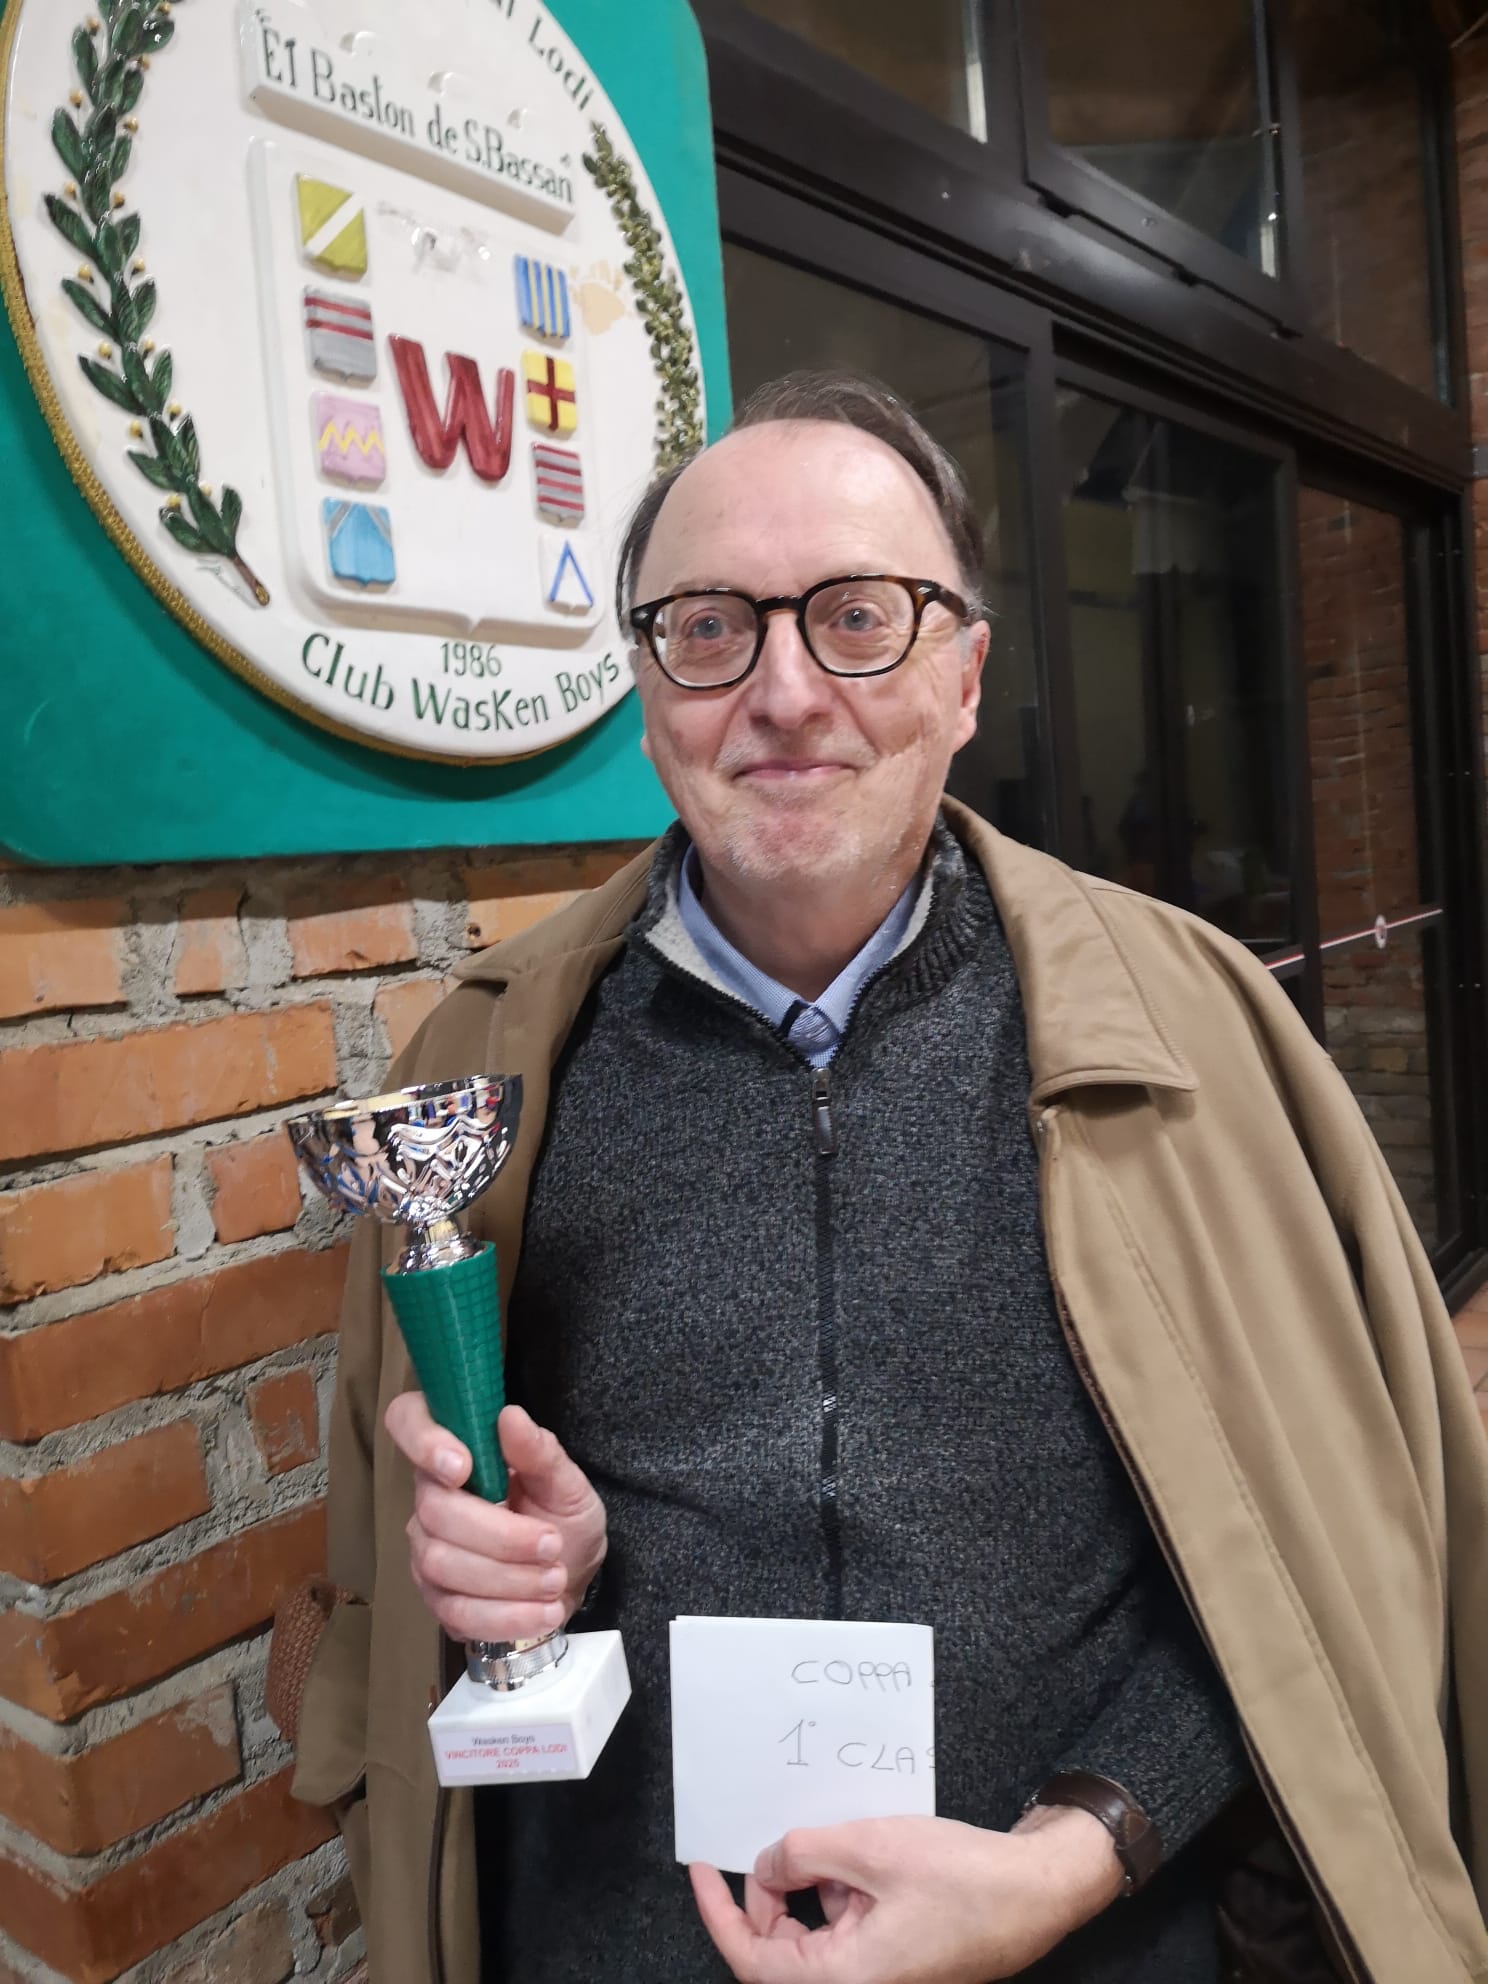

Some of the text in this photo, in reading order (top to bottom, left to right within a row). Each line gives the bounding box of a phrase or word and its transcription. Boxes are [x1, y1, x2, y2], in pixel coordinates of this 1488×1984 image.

[427, 103, 457, 154] de
[387, 332, 515, 481] W
[302, 632, 395, 710] Club
[556, 652, 621, 714] Boys
[440, 642, 501, 677] 1986
[791, 1660, 911, 1692] COPPA
[503, 1746, 538, 1756] COPPA
[541, 1743, 567, 1753] LODI
